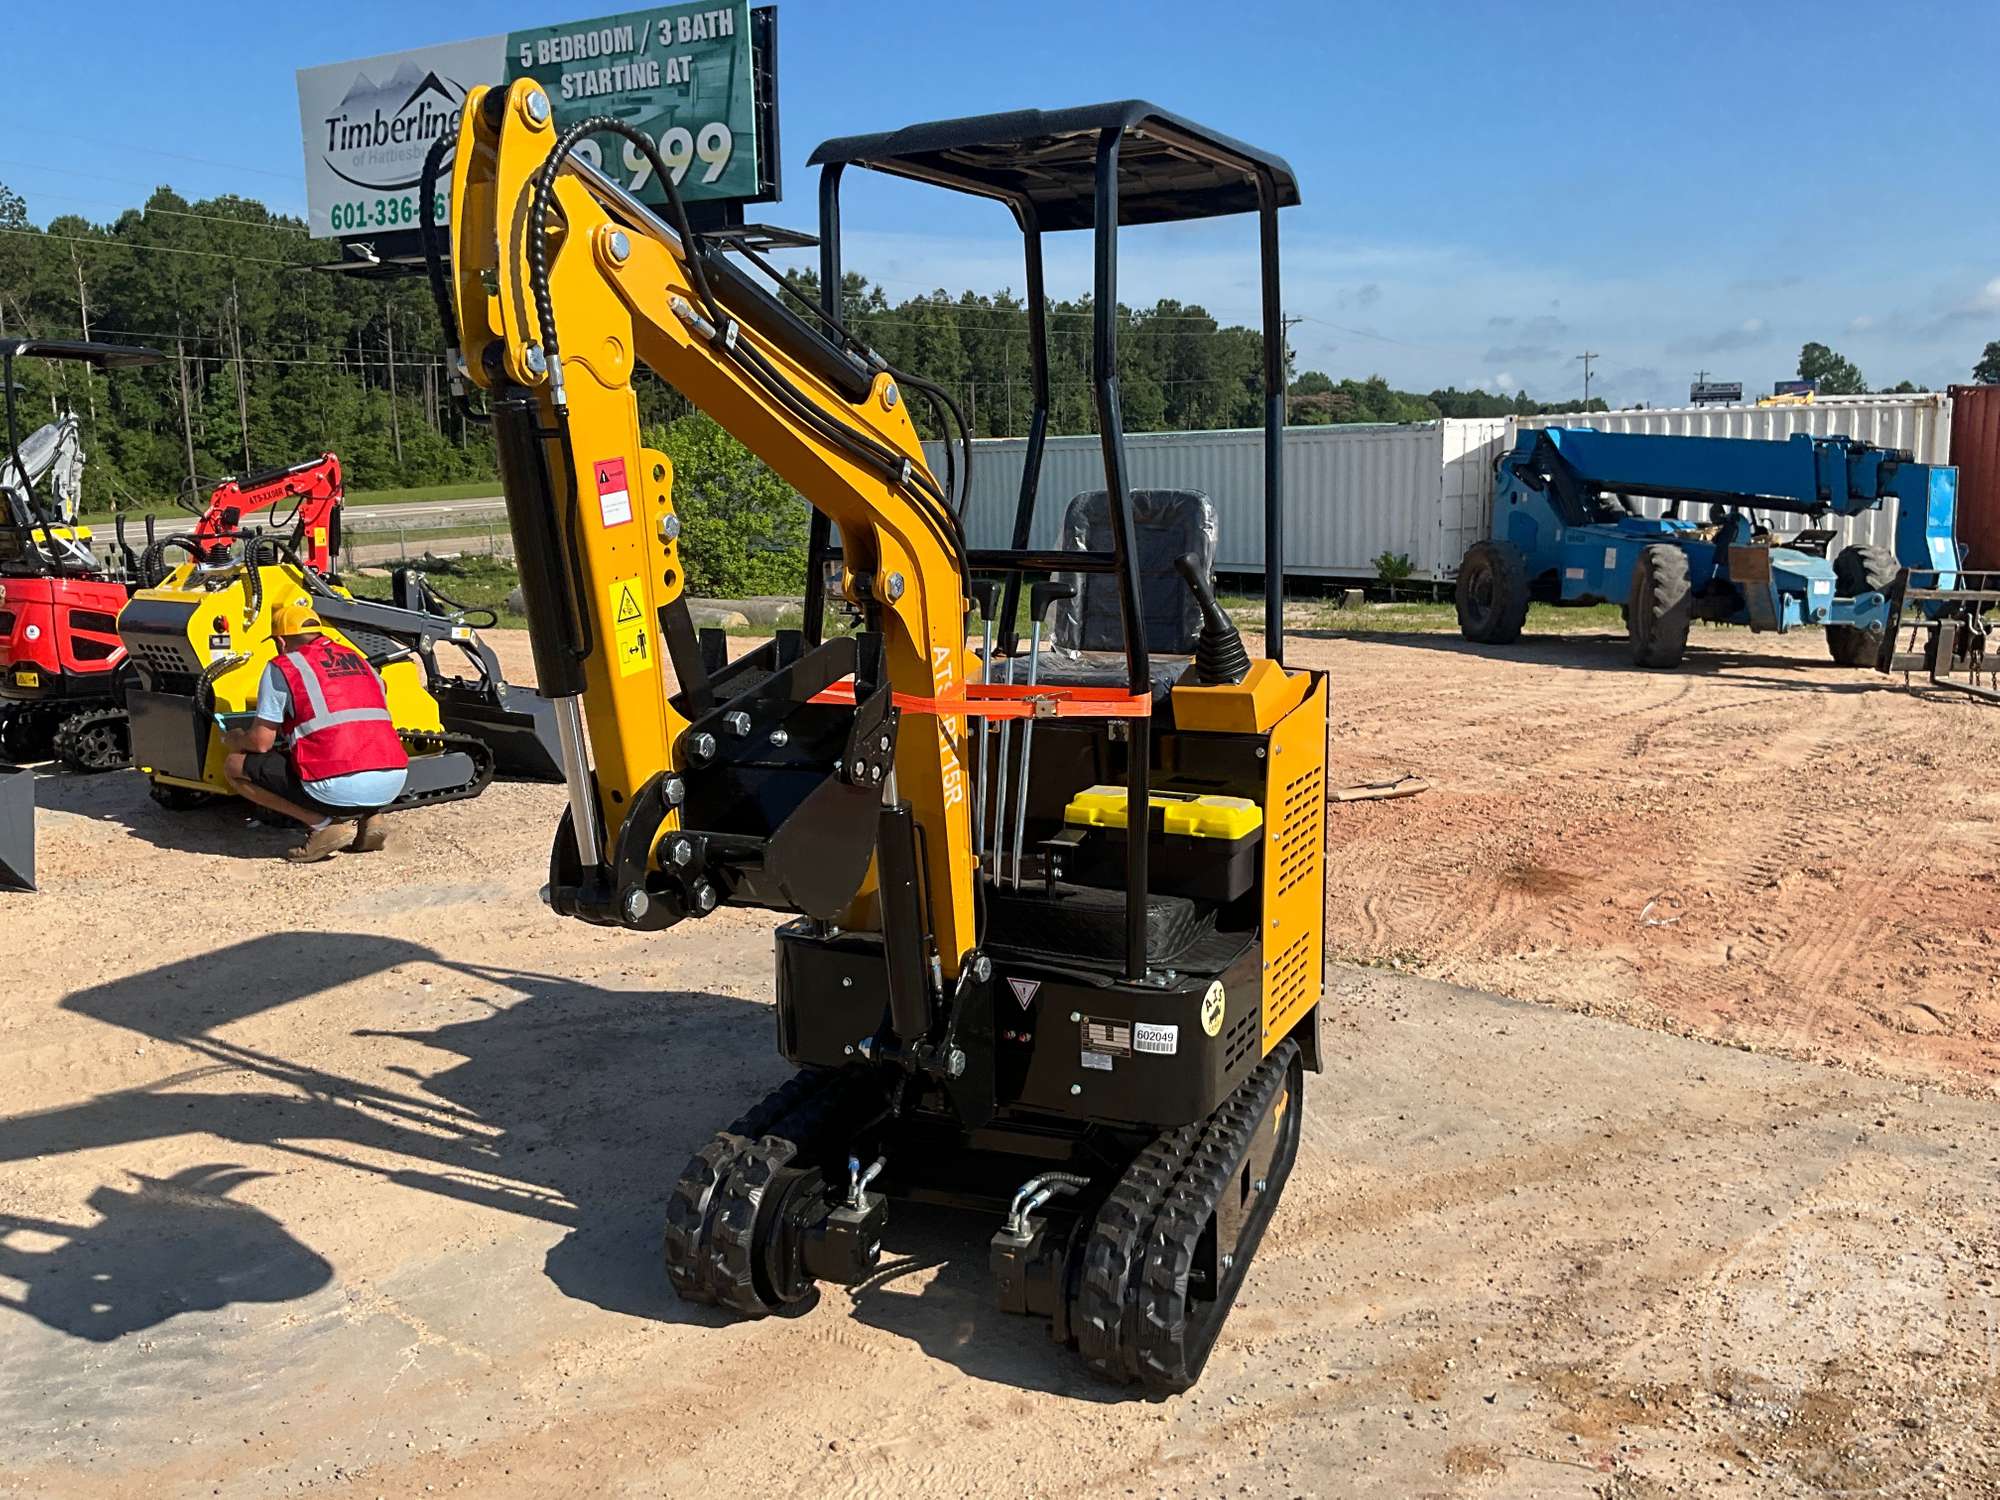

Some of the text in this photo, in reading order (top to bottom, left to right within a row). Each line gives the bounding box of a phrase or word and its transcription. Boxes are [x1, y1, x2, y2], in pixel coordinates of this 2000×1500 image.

[520, 43, 533, 67] 5
[537, 26, 634, 65] BEDROOM
[658, 19, 672, 46] 3
[677, 8, 734, 43] BATH
[561, 56, 693, 99] STARTING AT
[325, 101, 460, 152] Timberline
[1136, 1029, 1174, 1042] 602049
